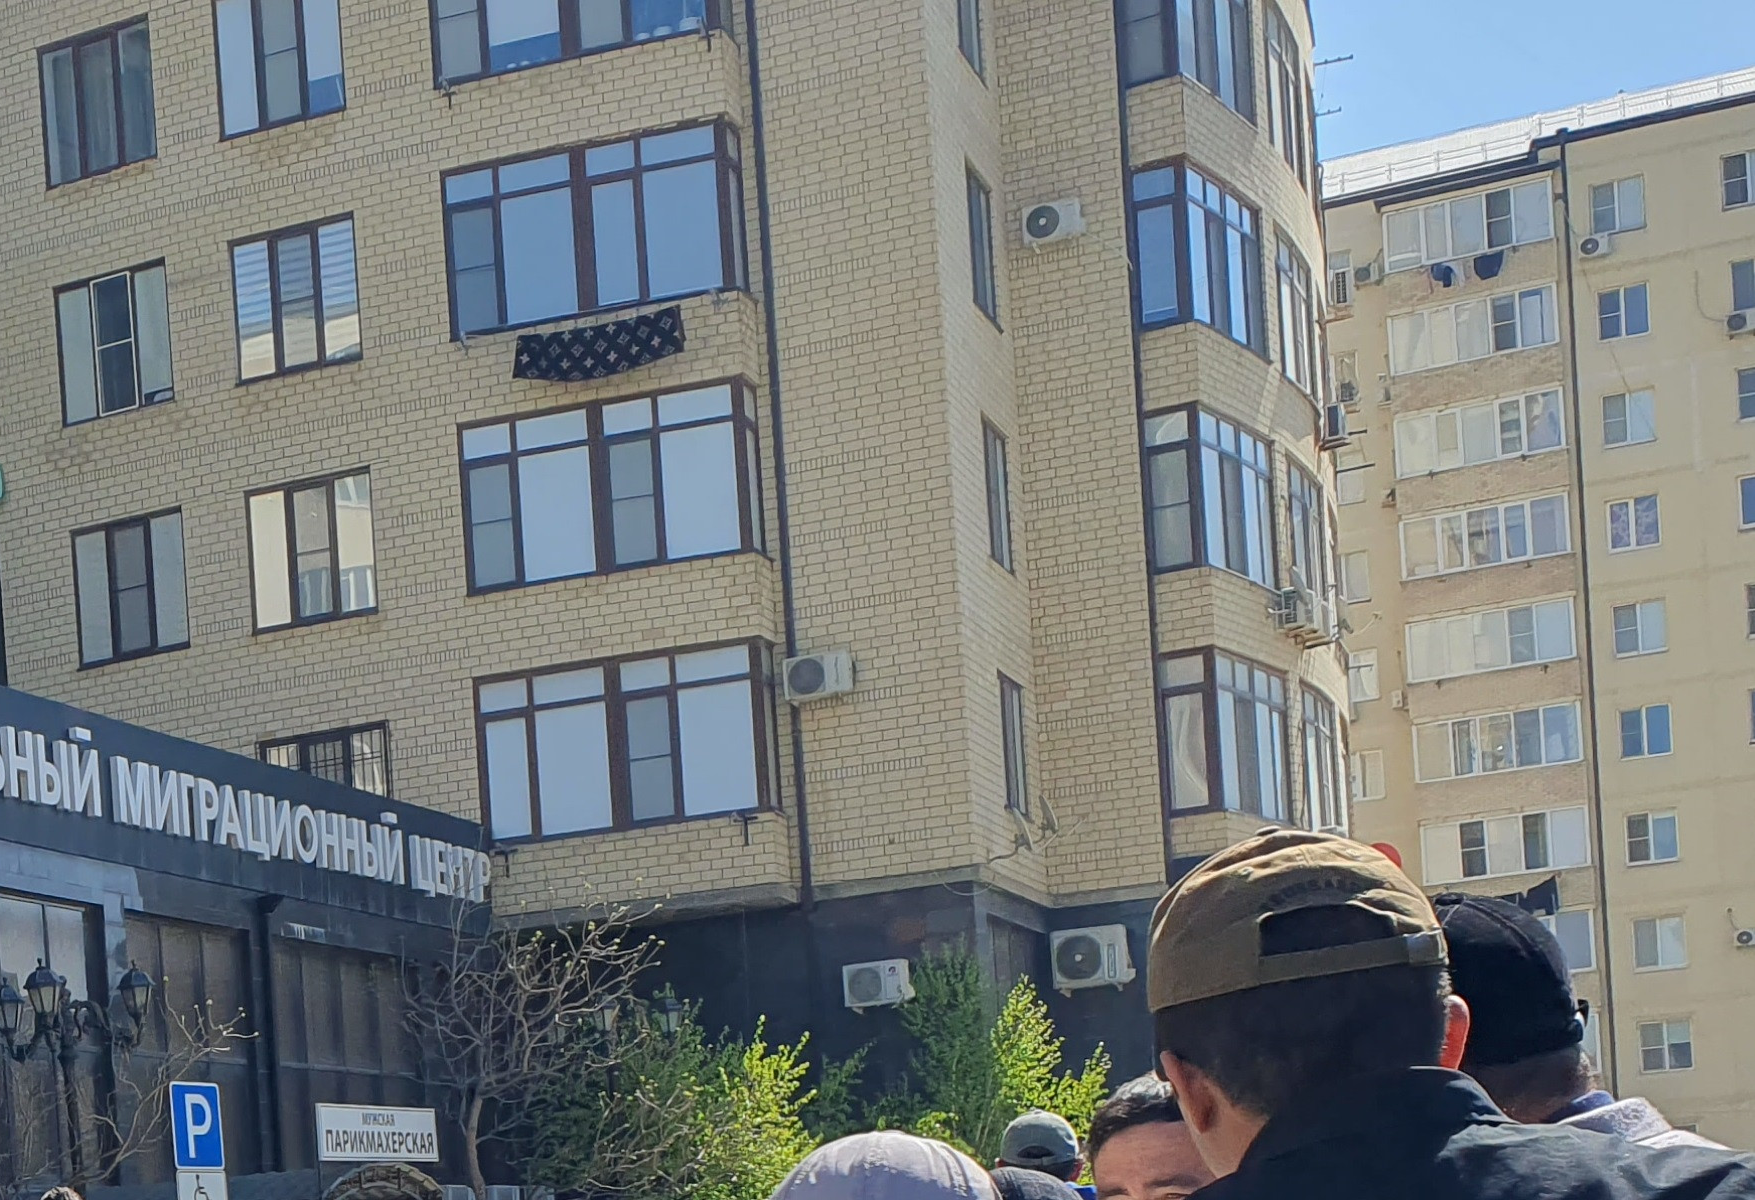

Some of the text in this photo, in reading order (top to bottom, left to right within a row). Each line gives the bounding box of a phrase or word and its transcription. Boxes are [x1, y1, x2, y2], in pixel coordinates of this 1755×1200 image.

[109, 754, 406, 886] МИГРАЦИОННЫЙ
[408, 834, 491, 904] ЦЕНТР
[184, 1092, 213, 1159] P
[325, 1128, 435, 1155] ПАРИКМАХЕРСКАЯ
[361, 1112, 395, 1127] МУЖСКАЯ
